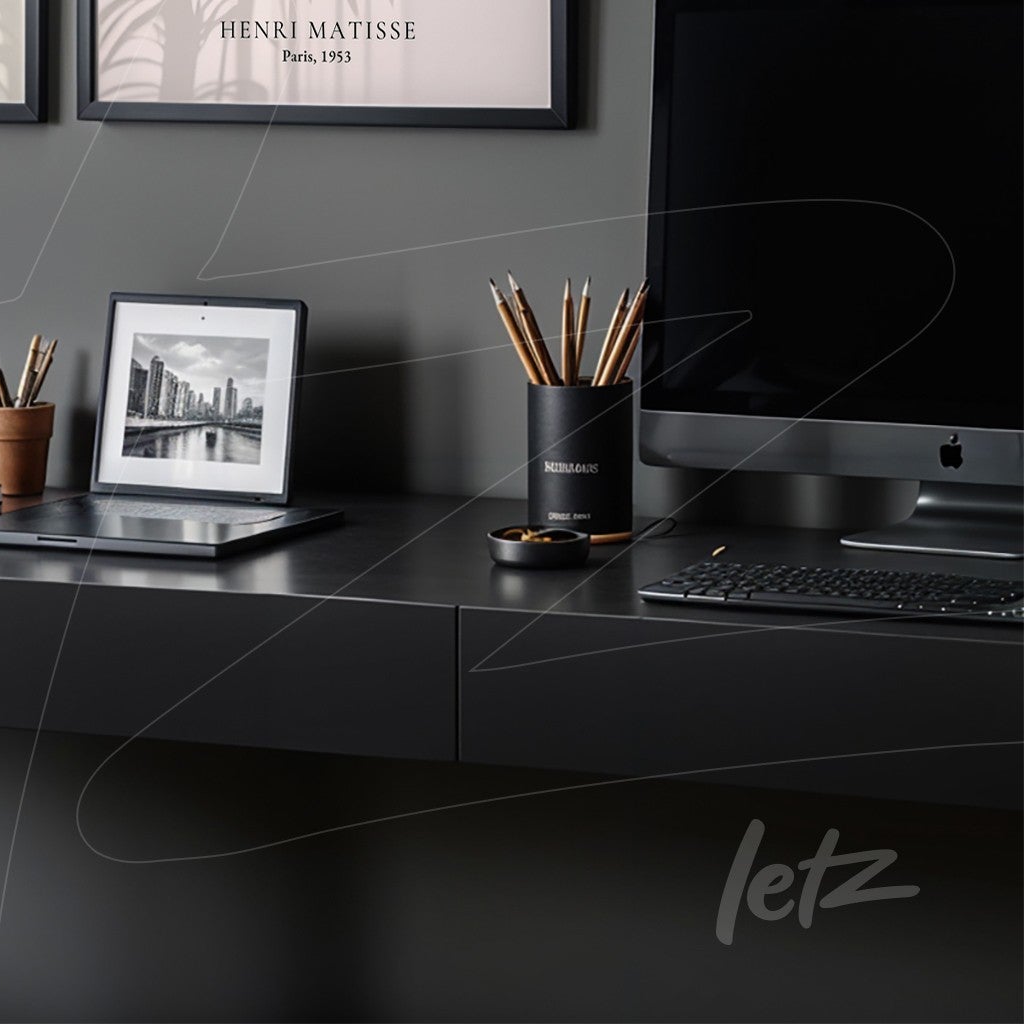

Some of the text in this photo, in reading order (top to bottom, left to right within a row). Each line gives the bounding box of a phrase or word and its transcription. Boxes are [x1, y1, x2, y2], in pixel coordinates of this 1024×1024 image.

[221, 20, 416, 40] HENRI MATISSE
[283, 49, 351, 65] Paris, 1953
